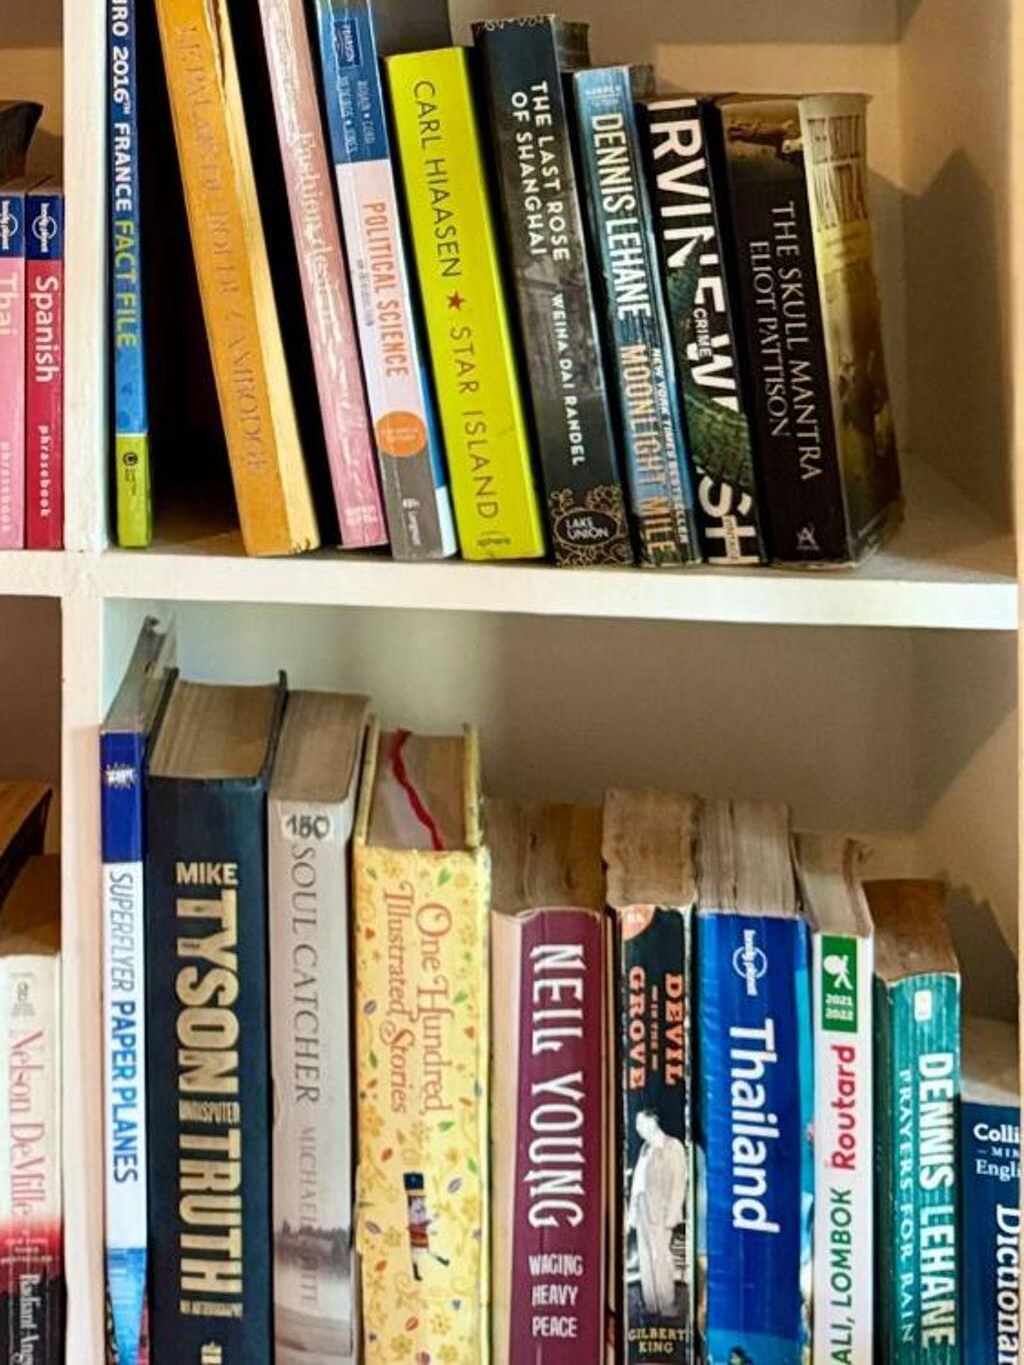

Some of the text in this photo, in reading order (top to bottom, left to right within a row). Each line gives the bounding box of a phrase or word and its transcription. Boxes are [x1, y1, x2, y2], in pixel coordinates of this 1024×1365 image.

[511, 92, 531, 122] OF
[530, 80, 561, 191] THE LAST
[113, 122, 133, 212] FRANCE
[591, 111, 636, 214] DENNIS
[114, 219, 135, 282] FACT
[413, 80, 500, 521] CARL HIAASEN STAR ISLAND
[604, 217, 652, 321] LEHANE
[31, 276, 60, 383] Spanish
[114, 289, 139, 348] FILE
[770, 200, 825, 481] THE SKULL MANTRA
[38, 425, 53, 518] phrasebook
[565, 517, 594, 531] LAKE
[566, 525, 610, 541] UNION
[177, 862, 239, 885] MIKE
[176, 889, 241, 1094] TYSON
[290, 843, 320, 1107] SOUL CATCHER
[378, 880, 416, 1115] Illustrated Stories
[415, 901, 455, 1114] One Hundred
[8, 1029, 44, 1115] Nelson
[108, 872, 139, 1185] SUPERFLYER PAPER PLANES
[627, 965, 647, 1091] GROVE
[664, 972, 684, 1087] DEVIL
[523, 943, 587, 1229] NEIL YOUNG
[728, 1018, 782, 1234] Thailand
[9, 1123, 46, 1216] DeMille
[179, 1128, 243, 1295] TRUTH
[830, 1044, 857, 1303] LOMBOK Routard
[918, 1051, 956, 1351] DENNIS LEHANE
[528, 1253, 583, 1276] WAGING
[531, 1284, 579, 1308] HEAVY
[900, 1273, 915, 1345] RAIN
[531, 1315, 578, 1338] PEACE
[627, 1327, 688, 1343] GILBERT
